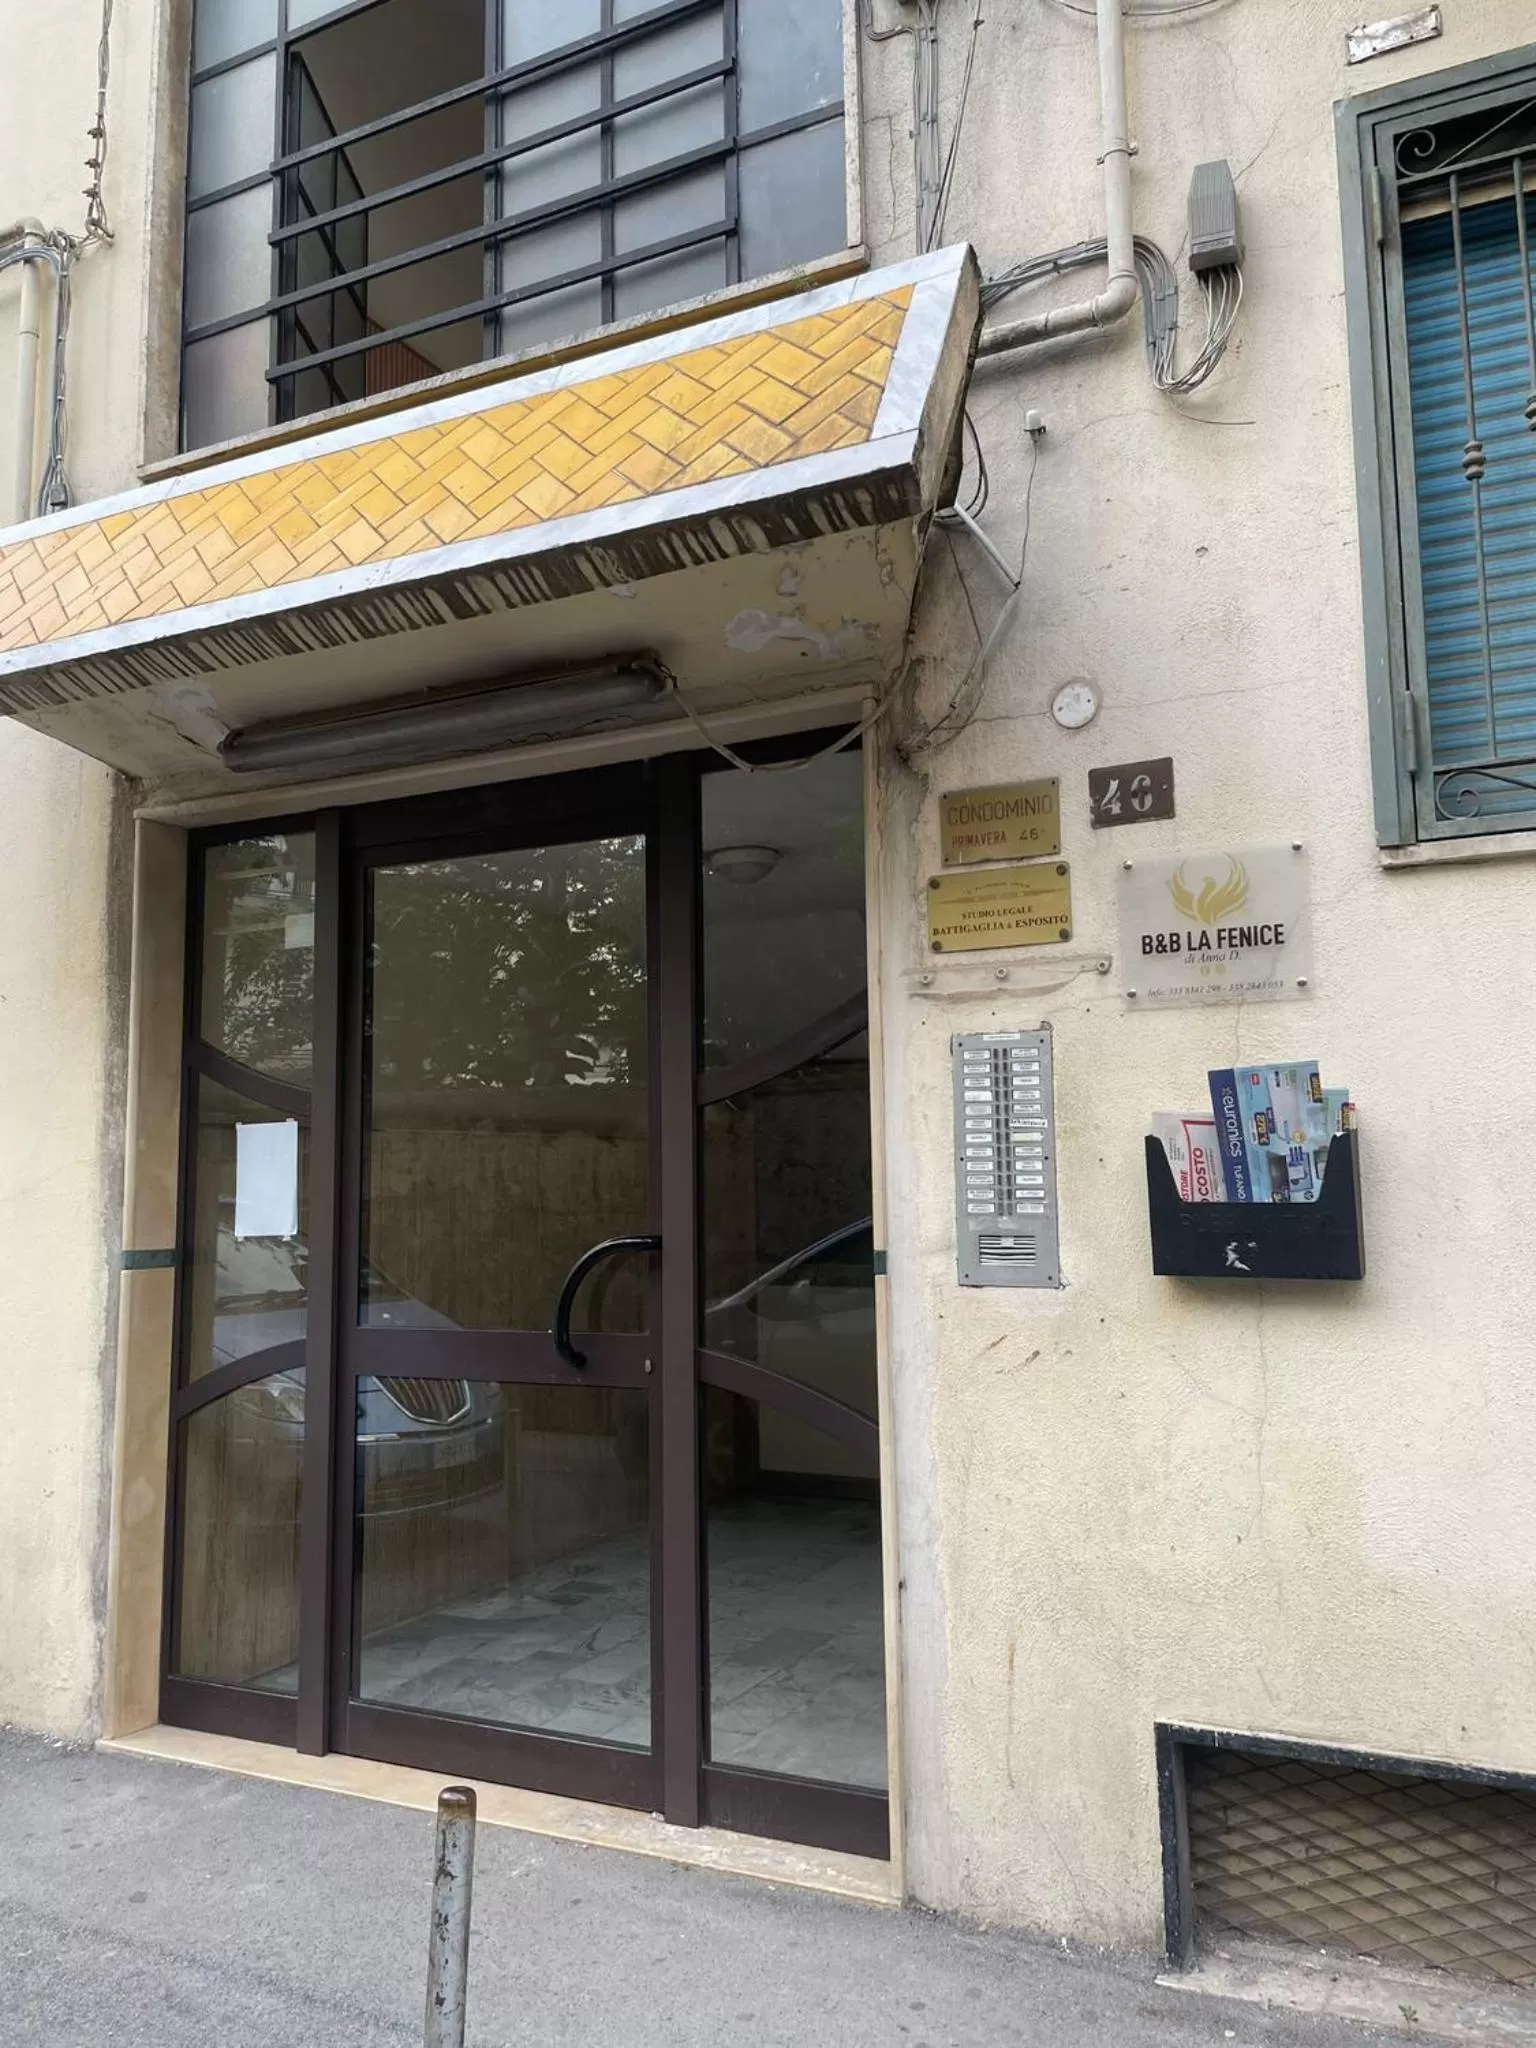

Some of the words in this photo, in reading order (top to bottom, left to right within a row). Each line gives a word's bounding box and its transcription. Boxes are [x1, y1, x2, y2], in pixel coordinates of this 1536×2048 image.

[947, 794, 1053, 827] CONDOMINIO
[1100, 774, 1154, 817] 46
[951, 830, 1007, 849] PRIMAVERA
[932, 921, 1004, 937] BATTIGAGLIA
[1015, 913, 1069, 929] ESPOSITO
[961, 909, 995, 921] STUDIO
[997, 905, 1033, 917] LEGALE
[1141, 932, 1181, 956] B&B
[1187, 929, 1212, 951] LA
[1217, 923, 1285, 949] FENICE
[1197, 952, 1226, 964] Anna
[1221, 1096, 1243, 1157] euronics
[1233, 1164, 1248, 1200] TUFANO
